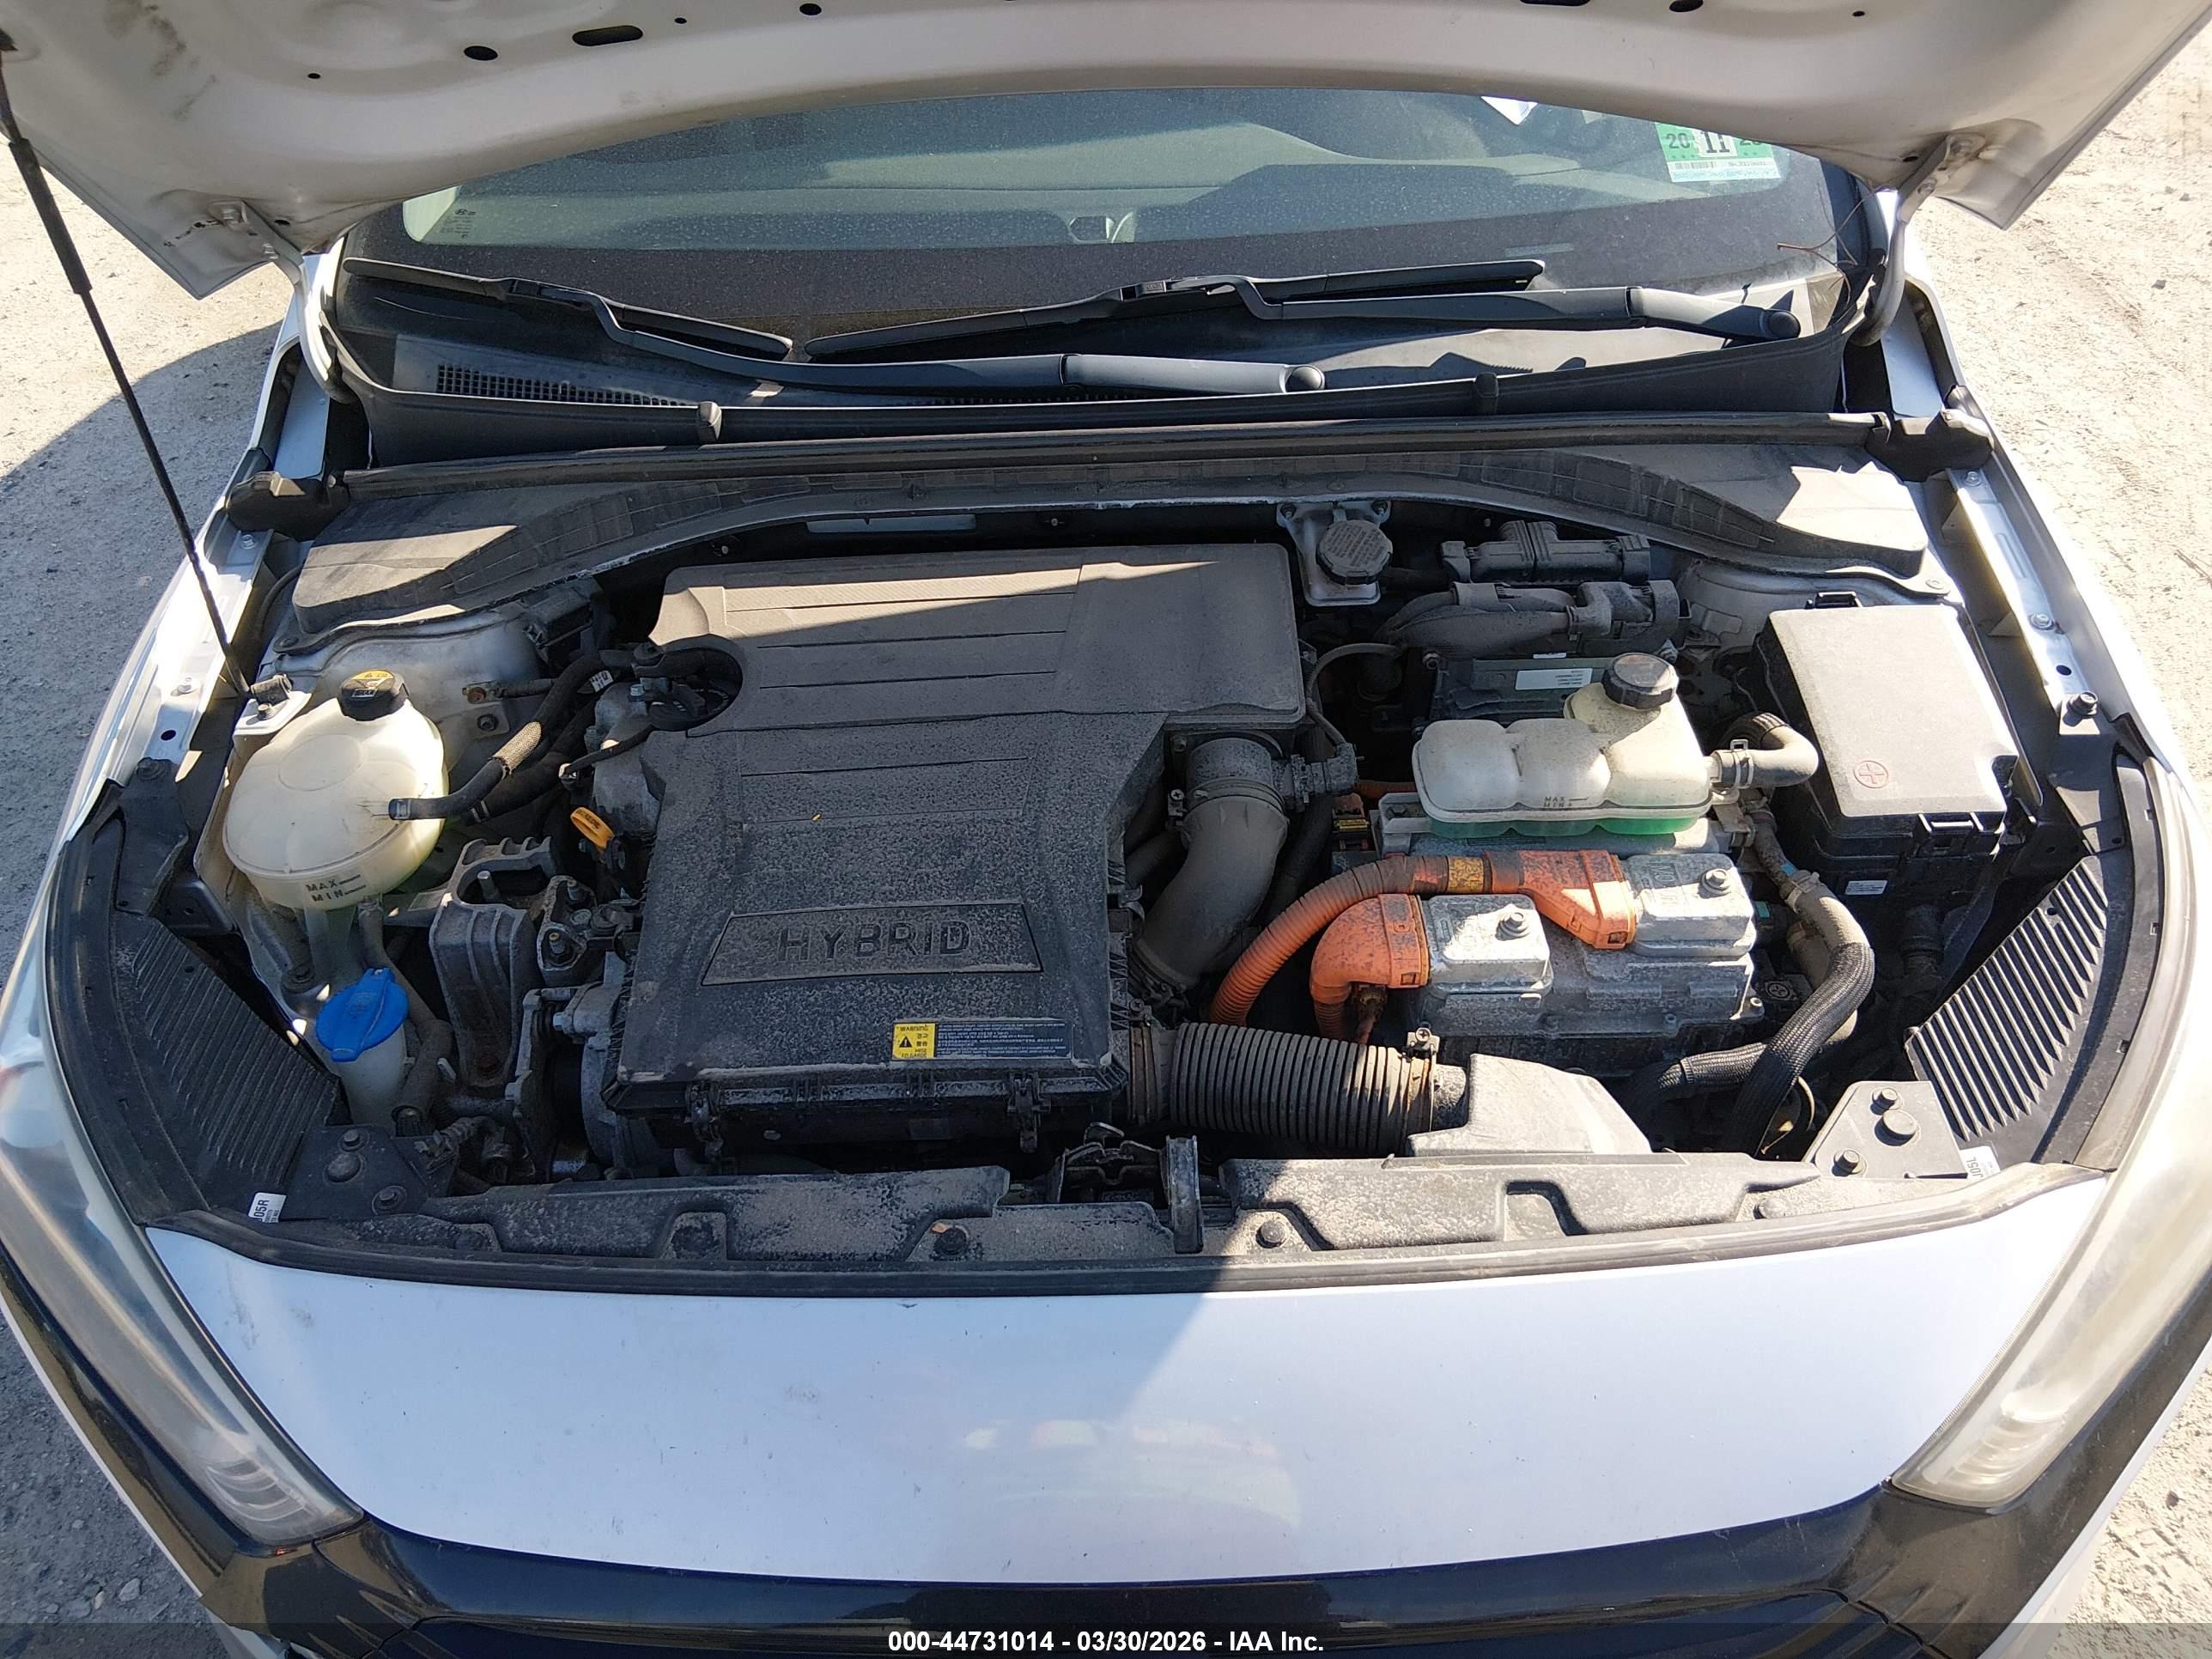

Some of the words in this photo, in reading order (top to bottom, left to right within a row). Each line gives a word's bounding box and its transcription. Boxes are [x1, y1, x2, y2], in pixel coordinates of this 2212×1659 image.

[1666, 132, 1691, 149] 20
[1700, 131, 1730, 153] 11
[305, 879, 338, 891] MAX
[311, 890, 343, 902] MIN
[777, 919, 972, 962] HYBRID
